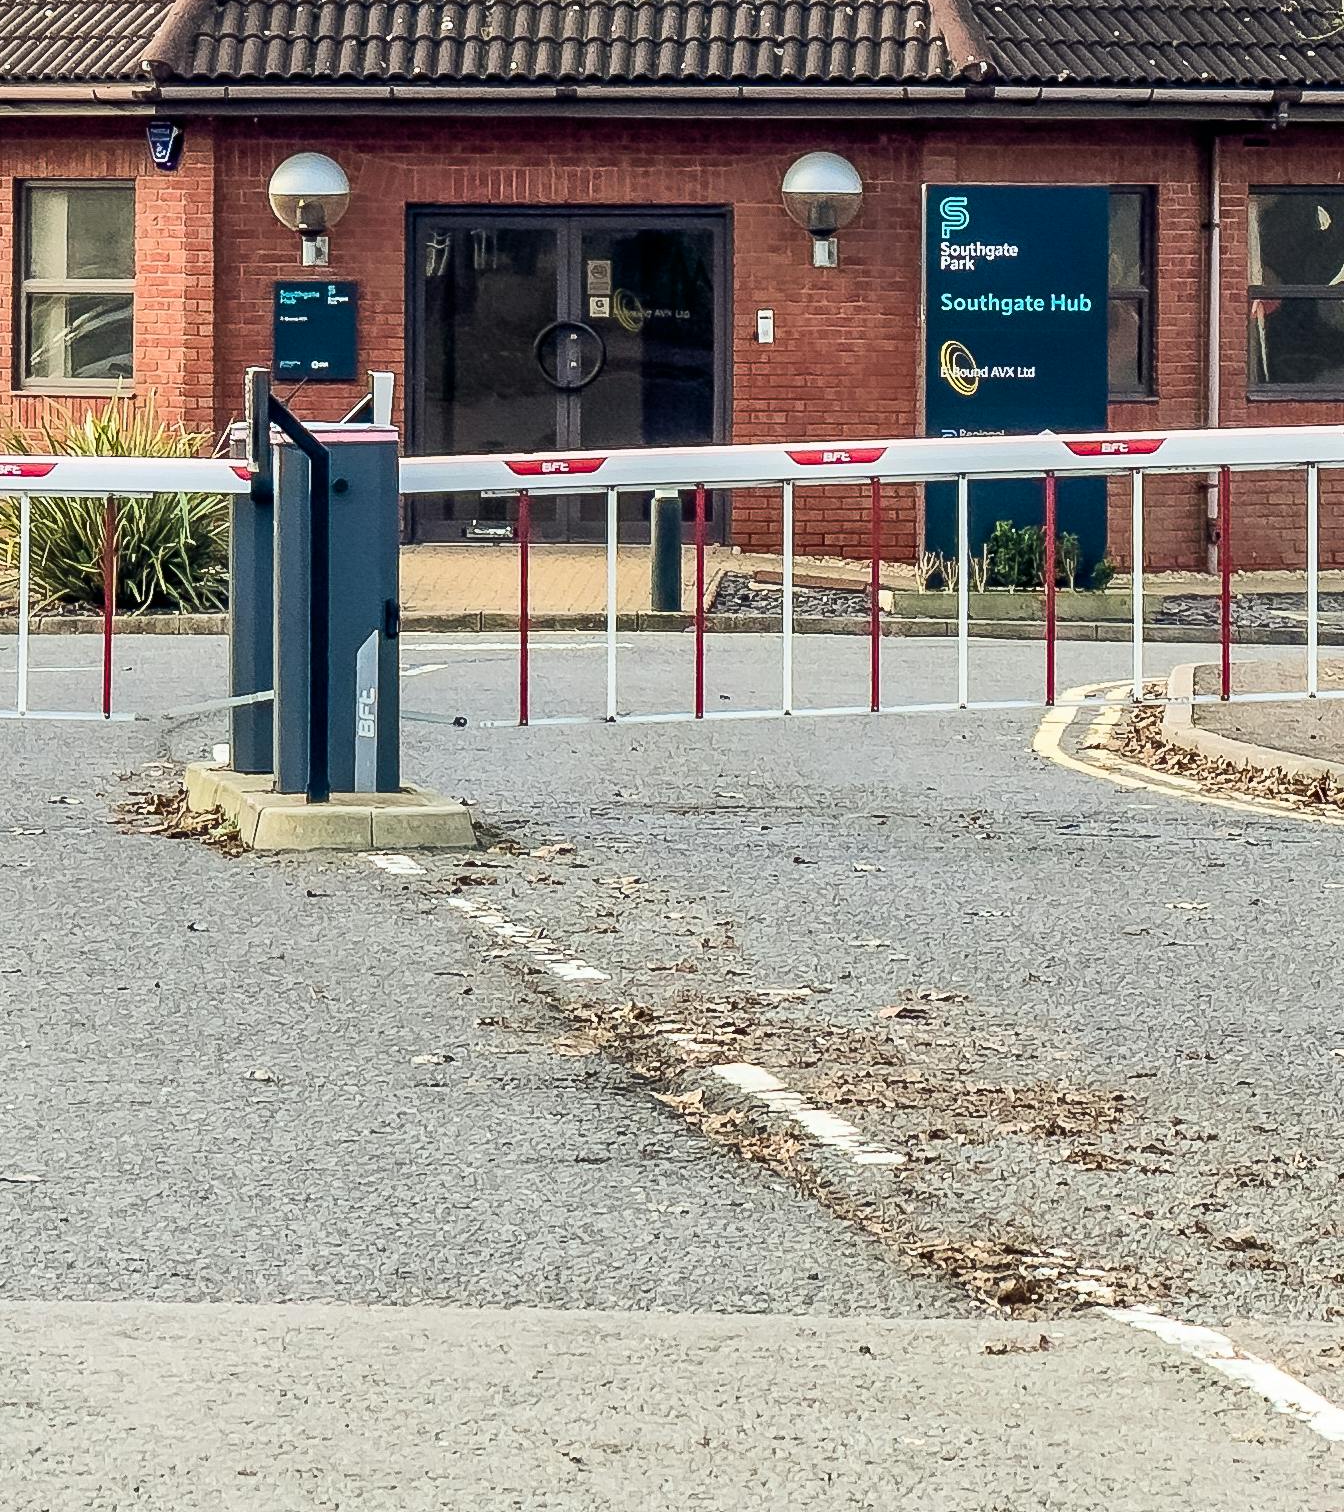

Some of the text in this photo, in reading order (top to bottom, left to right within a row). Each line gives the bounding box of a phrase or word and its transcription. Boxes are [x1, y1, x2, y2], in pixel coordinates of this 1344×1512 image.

[940, 241, 1019, 261] Southgate
[940, 255, 975, 271] Park
[940, 292, 1092, 316] Southgate Hub
[990, 366, 1015, 378] AVX
[1017, 366, 1036, 378] Ltd
